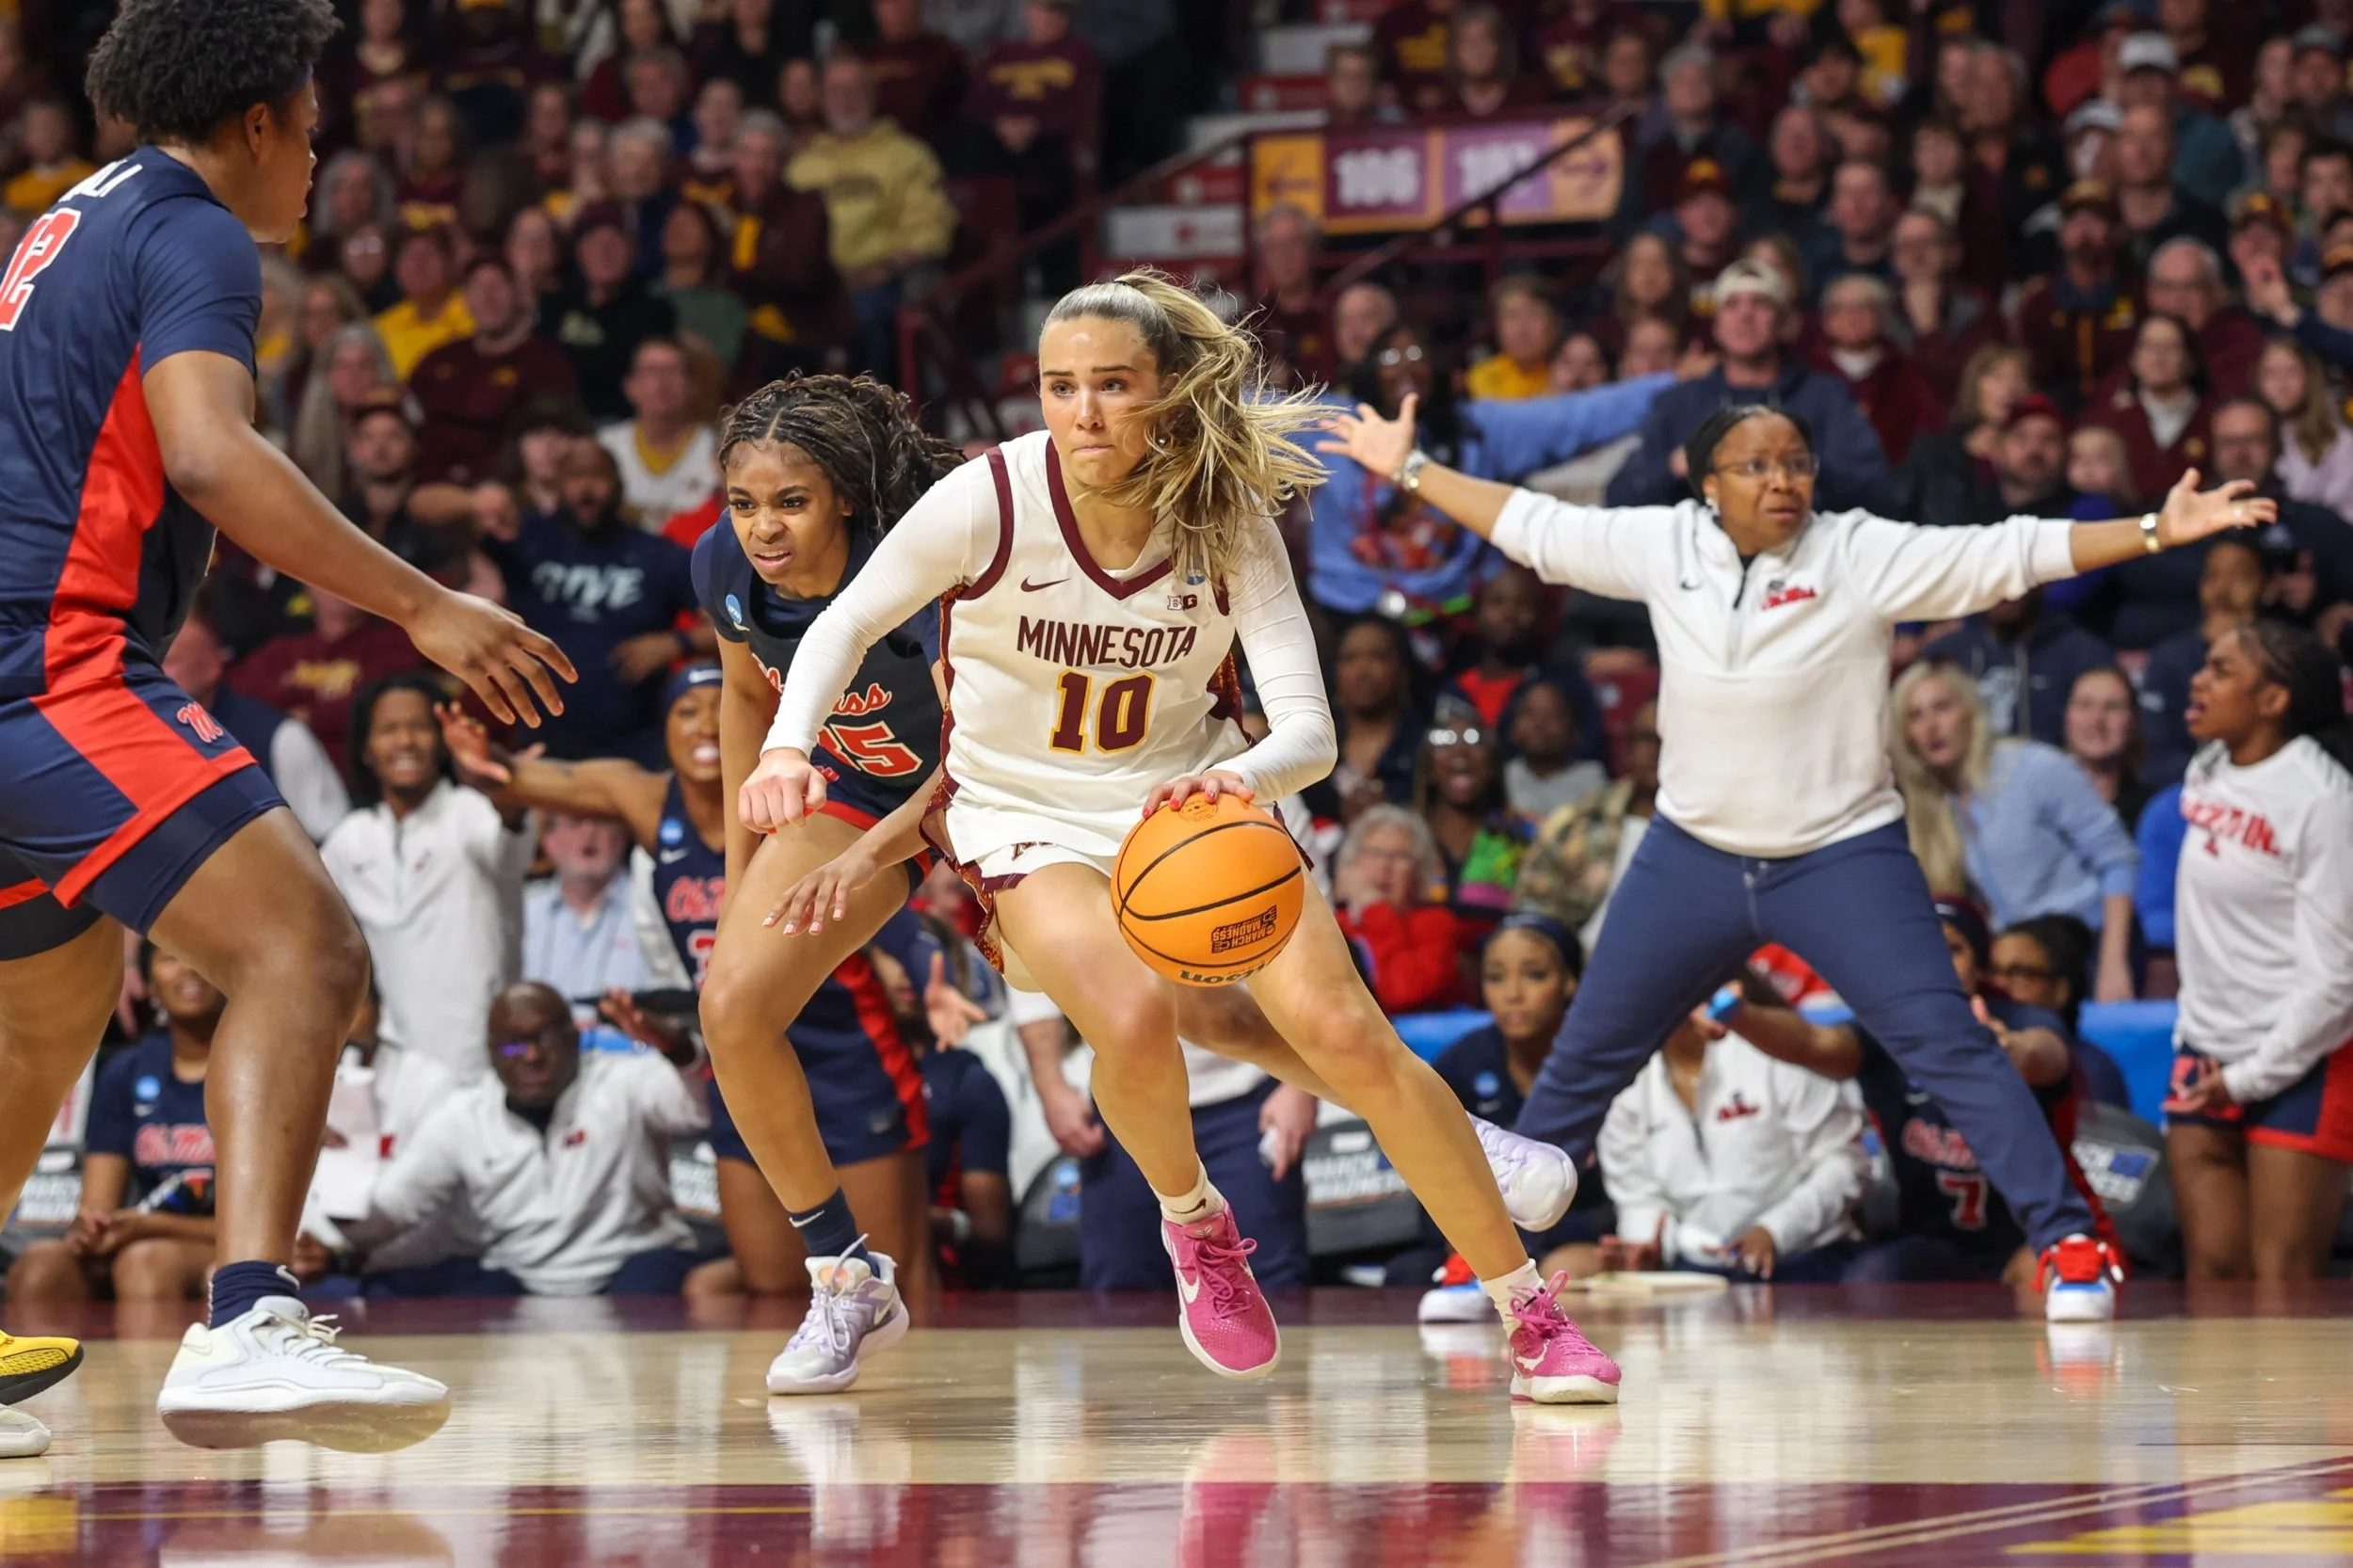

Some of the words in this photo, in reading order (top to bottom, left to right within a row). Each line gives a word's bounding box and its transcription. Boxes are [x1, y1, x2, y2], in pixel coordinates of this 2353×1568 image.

[1016, 615, 1197, 669] MINNESOTA
[831, 682, 892, 716] iss
[1048, 668, 1157, 756] 10
[1212, 919, 1262, 942] MADNESS
[1231, 929, 1265, 949] MARCH
[1935, 1169, 1988, 1229] 7
